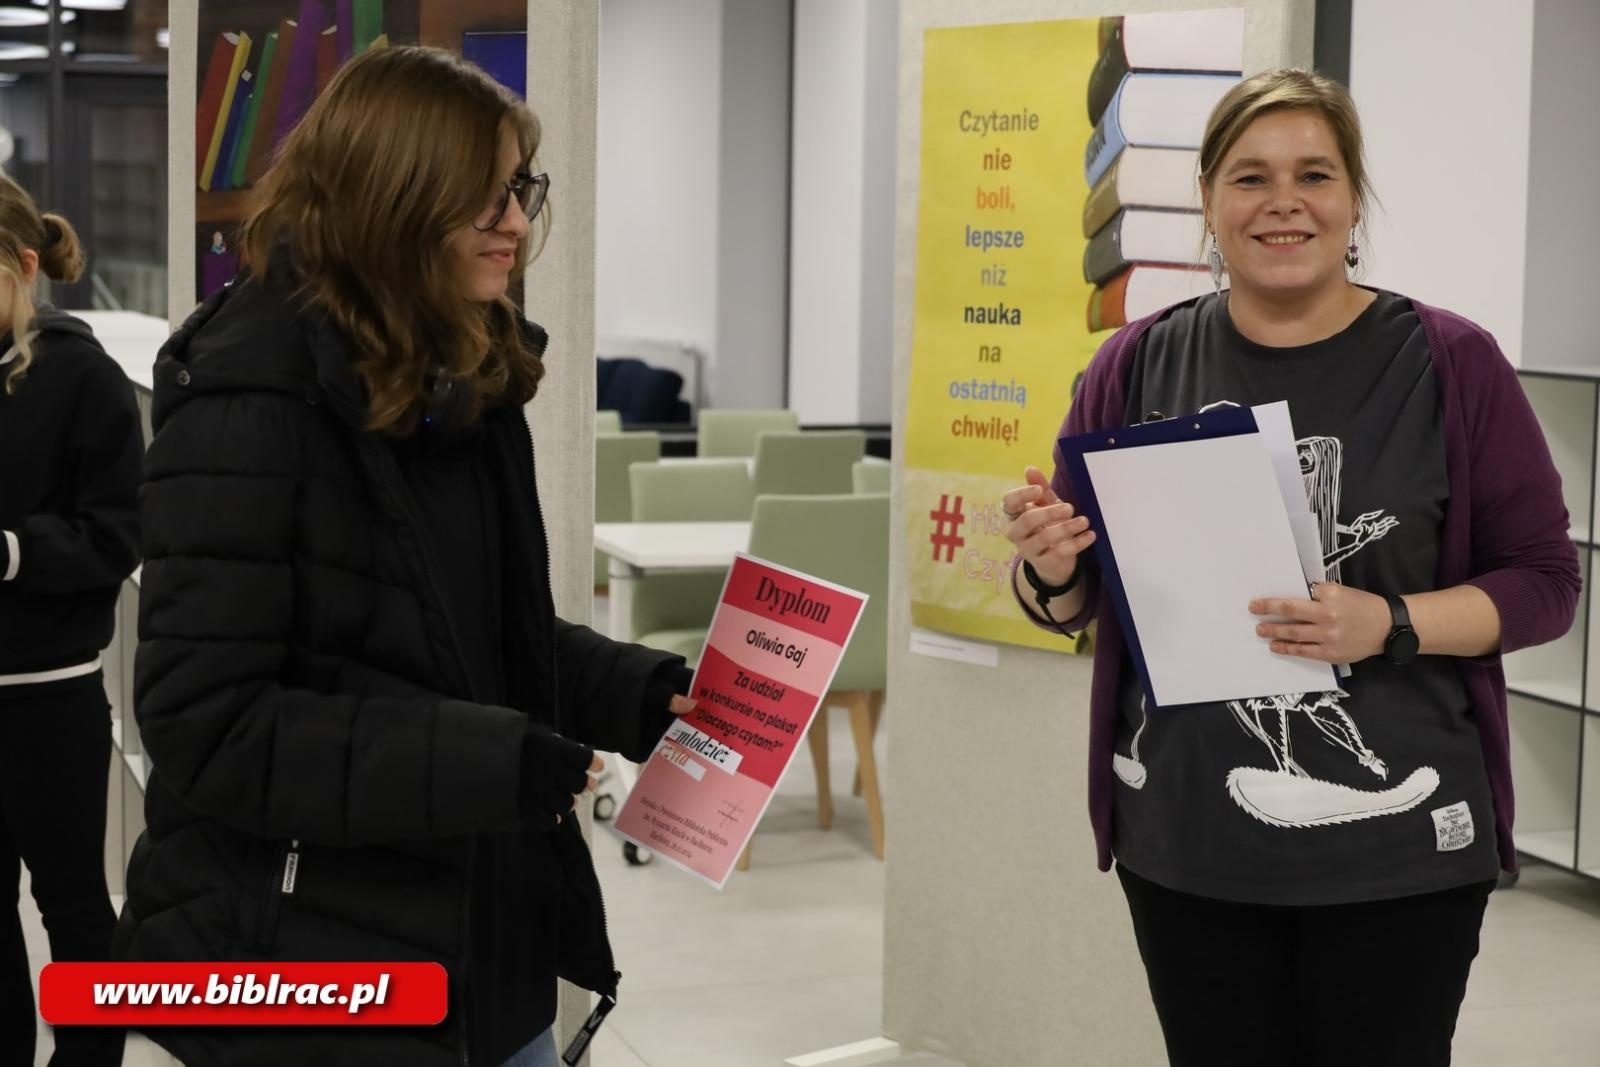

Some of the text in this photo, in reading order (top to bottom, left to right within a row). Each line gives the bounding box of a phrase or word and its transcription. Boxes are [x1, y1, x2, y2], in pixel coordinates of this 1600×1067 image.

[959, 108, 1039, 137] Czytanie
[983, 149, 1012, 171] nie
[976, 187, 1015, 212] boli,
[965, 225, 1024, 252] lepsze
[981, 263, 1006, 286] niż
[964, 303, 1021, 325] nauka
[979, 345, 1001, 363] na
[949, 379, 1027, 408] ostatnią
[951, 415, 1019, 446] chwilę!
[755, 576, 831, 624] Dyplom
[746, 629, 808, 668] Oliwia Gaj
[734, 671, 785, 702] Za udział
[700, 687, 798, 735] w konkursie na plakat
